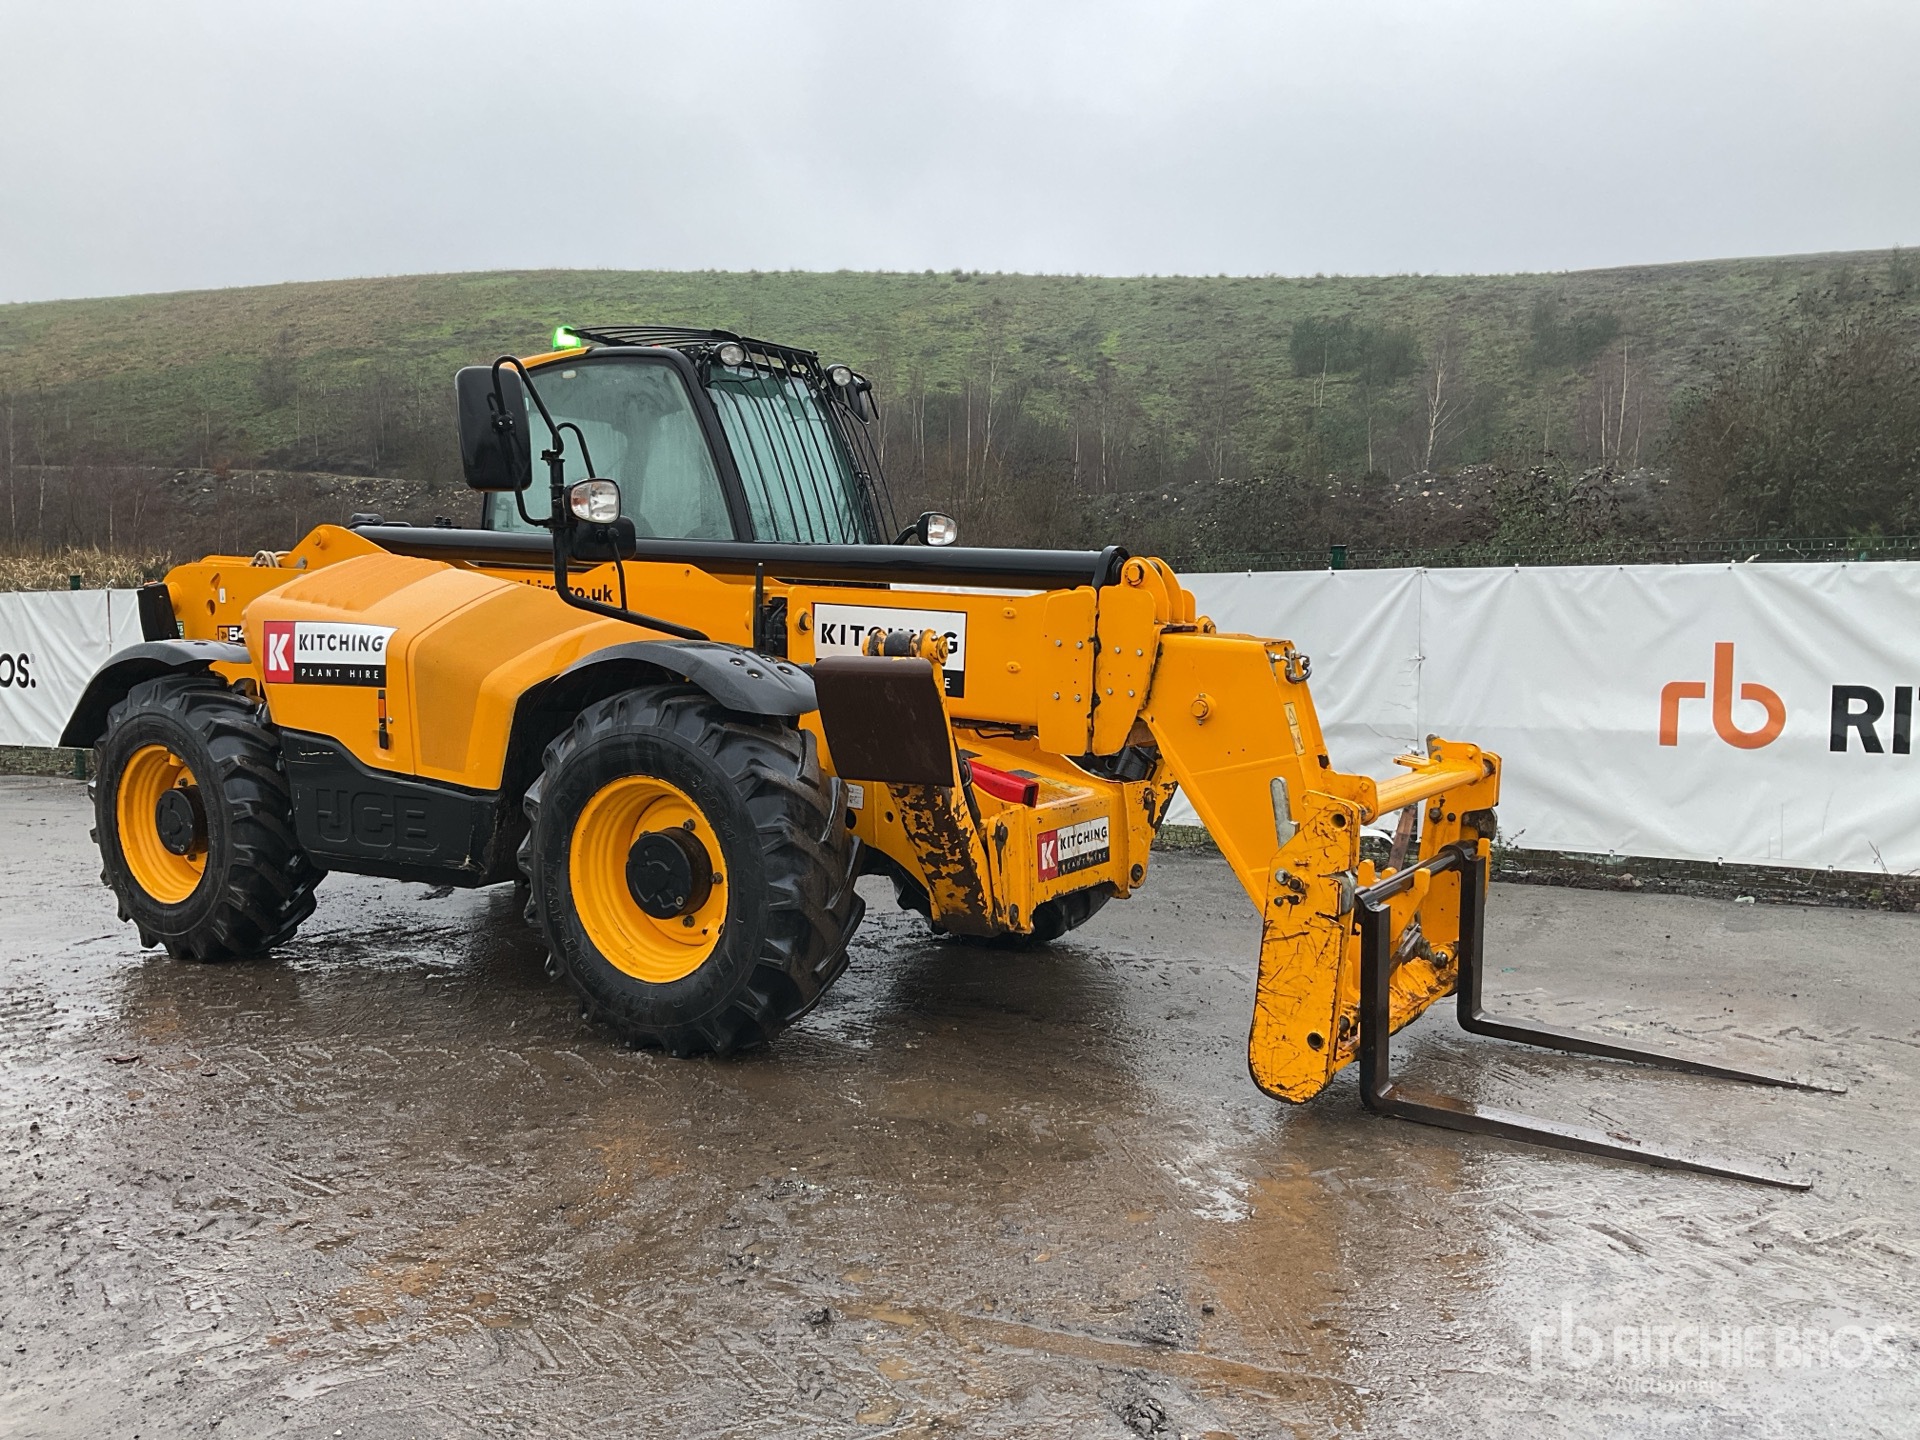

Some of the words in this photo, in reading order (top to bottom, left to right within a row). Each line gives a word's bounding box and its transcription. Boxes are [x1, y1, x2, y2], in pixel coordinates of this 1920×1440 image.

[268, 633, 291, 671] K
[299, 633, 384, 652] KITCHING
[821, 623, 958, 654] KITG
[301, 668, 340, 678] PLANT
[349, 669, 379, 679] HIRE
[1659, 642, 1787, 750] rb
[1829, 684, 1920, 754] RI
[1060, 826, 1108, 850] KITCHING
[1041, 839, 1056, 870] K
